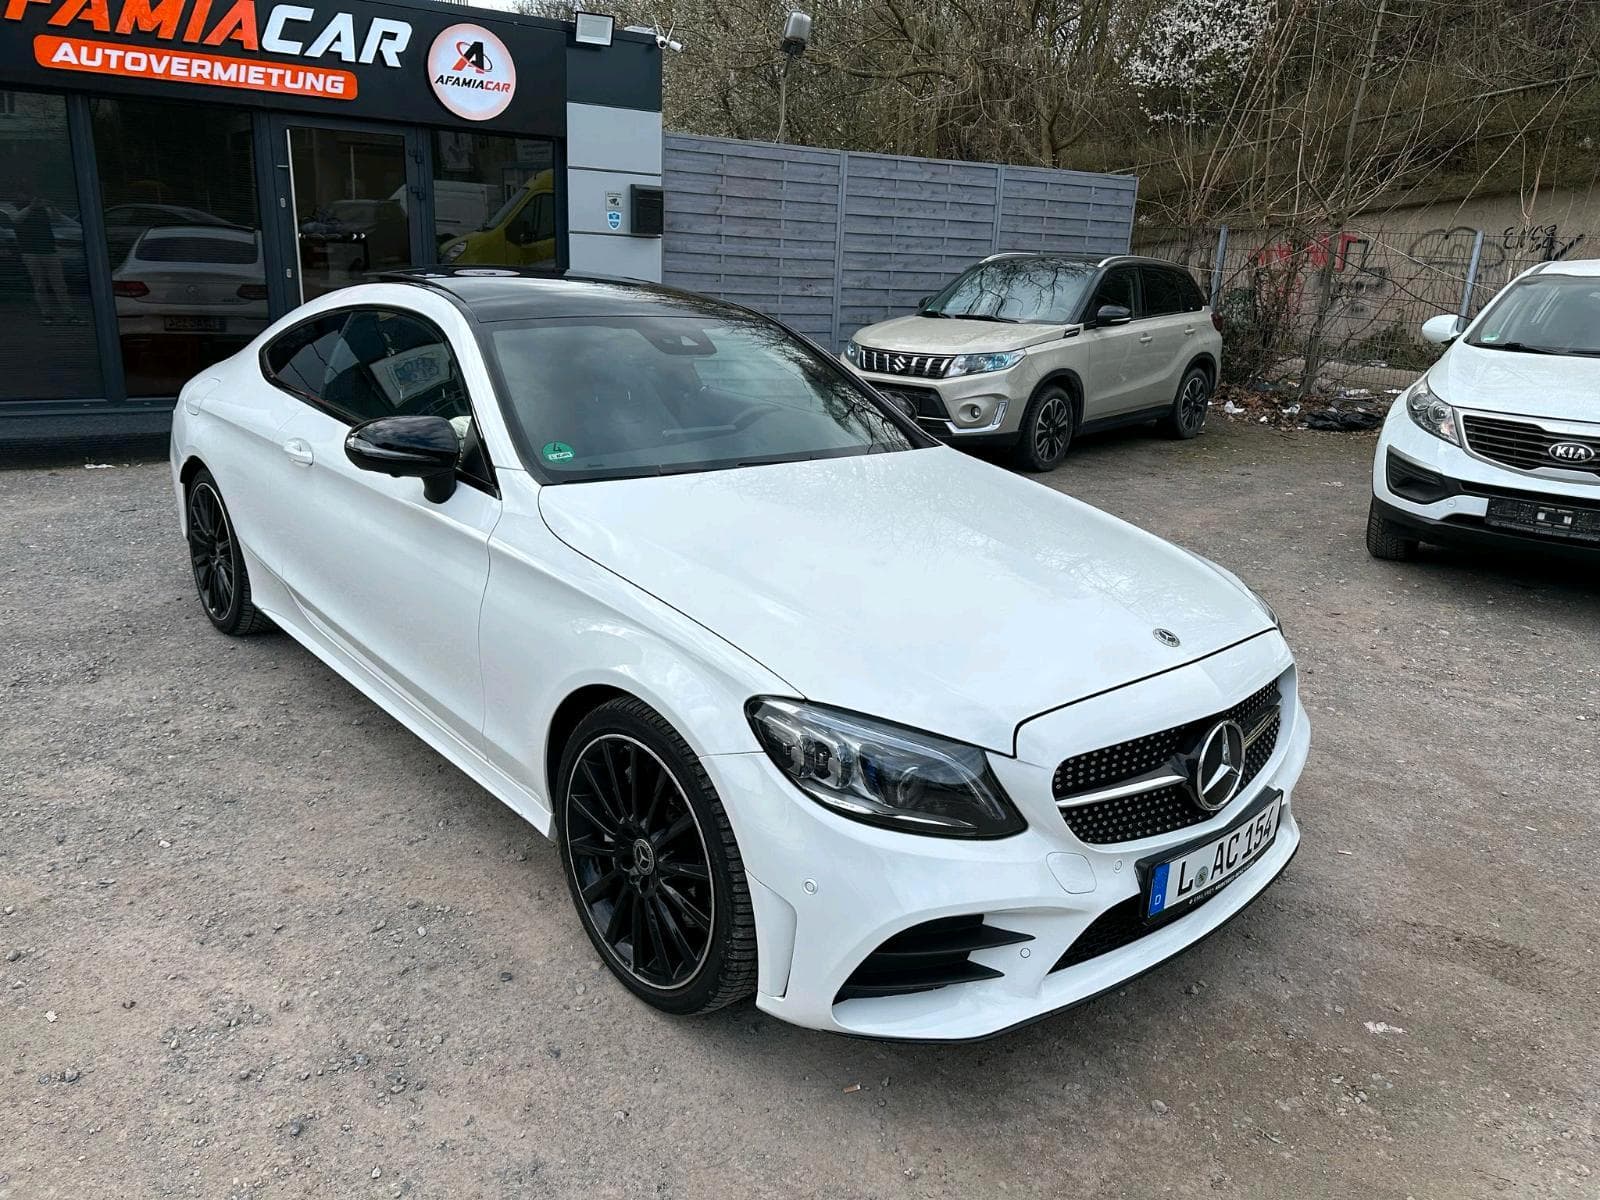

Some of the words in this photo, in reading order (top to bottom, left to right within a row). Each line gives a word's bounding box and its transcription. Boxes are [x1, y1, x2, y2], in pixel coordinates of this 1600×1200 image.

[51, 42, 345, 94] AUTOVERMIETUNG
[434, 74, 511, 93] AFAMIACAR
[553, 442, 563, 452] 4
[1555, 445, 1586, 460] KIA
[1178, 861, 1194, 896] L
[1210, 832, 1241, 880] AC
[1241, 806, 1274, 859] 154
[1154, 894, 1162, 905] D
